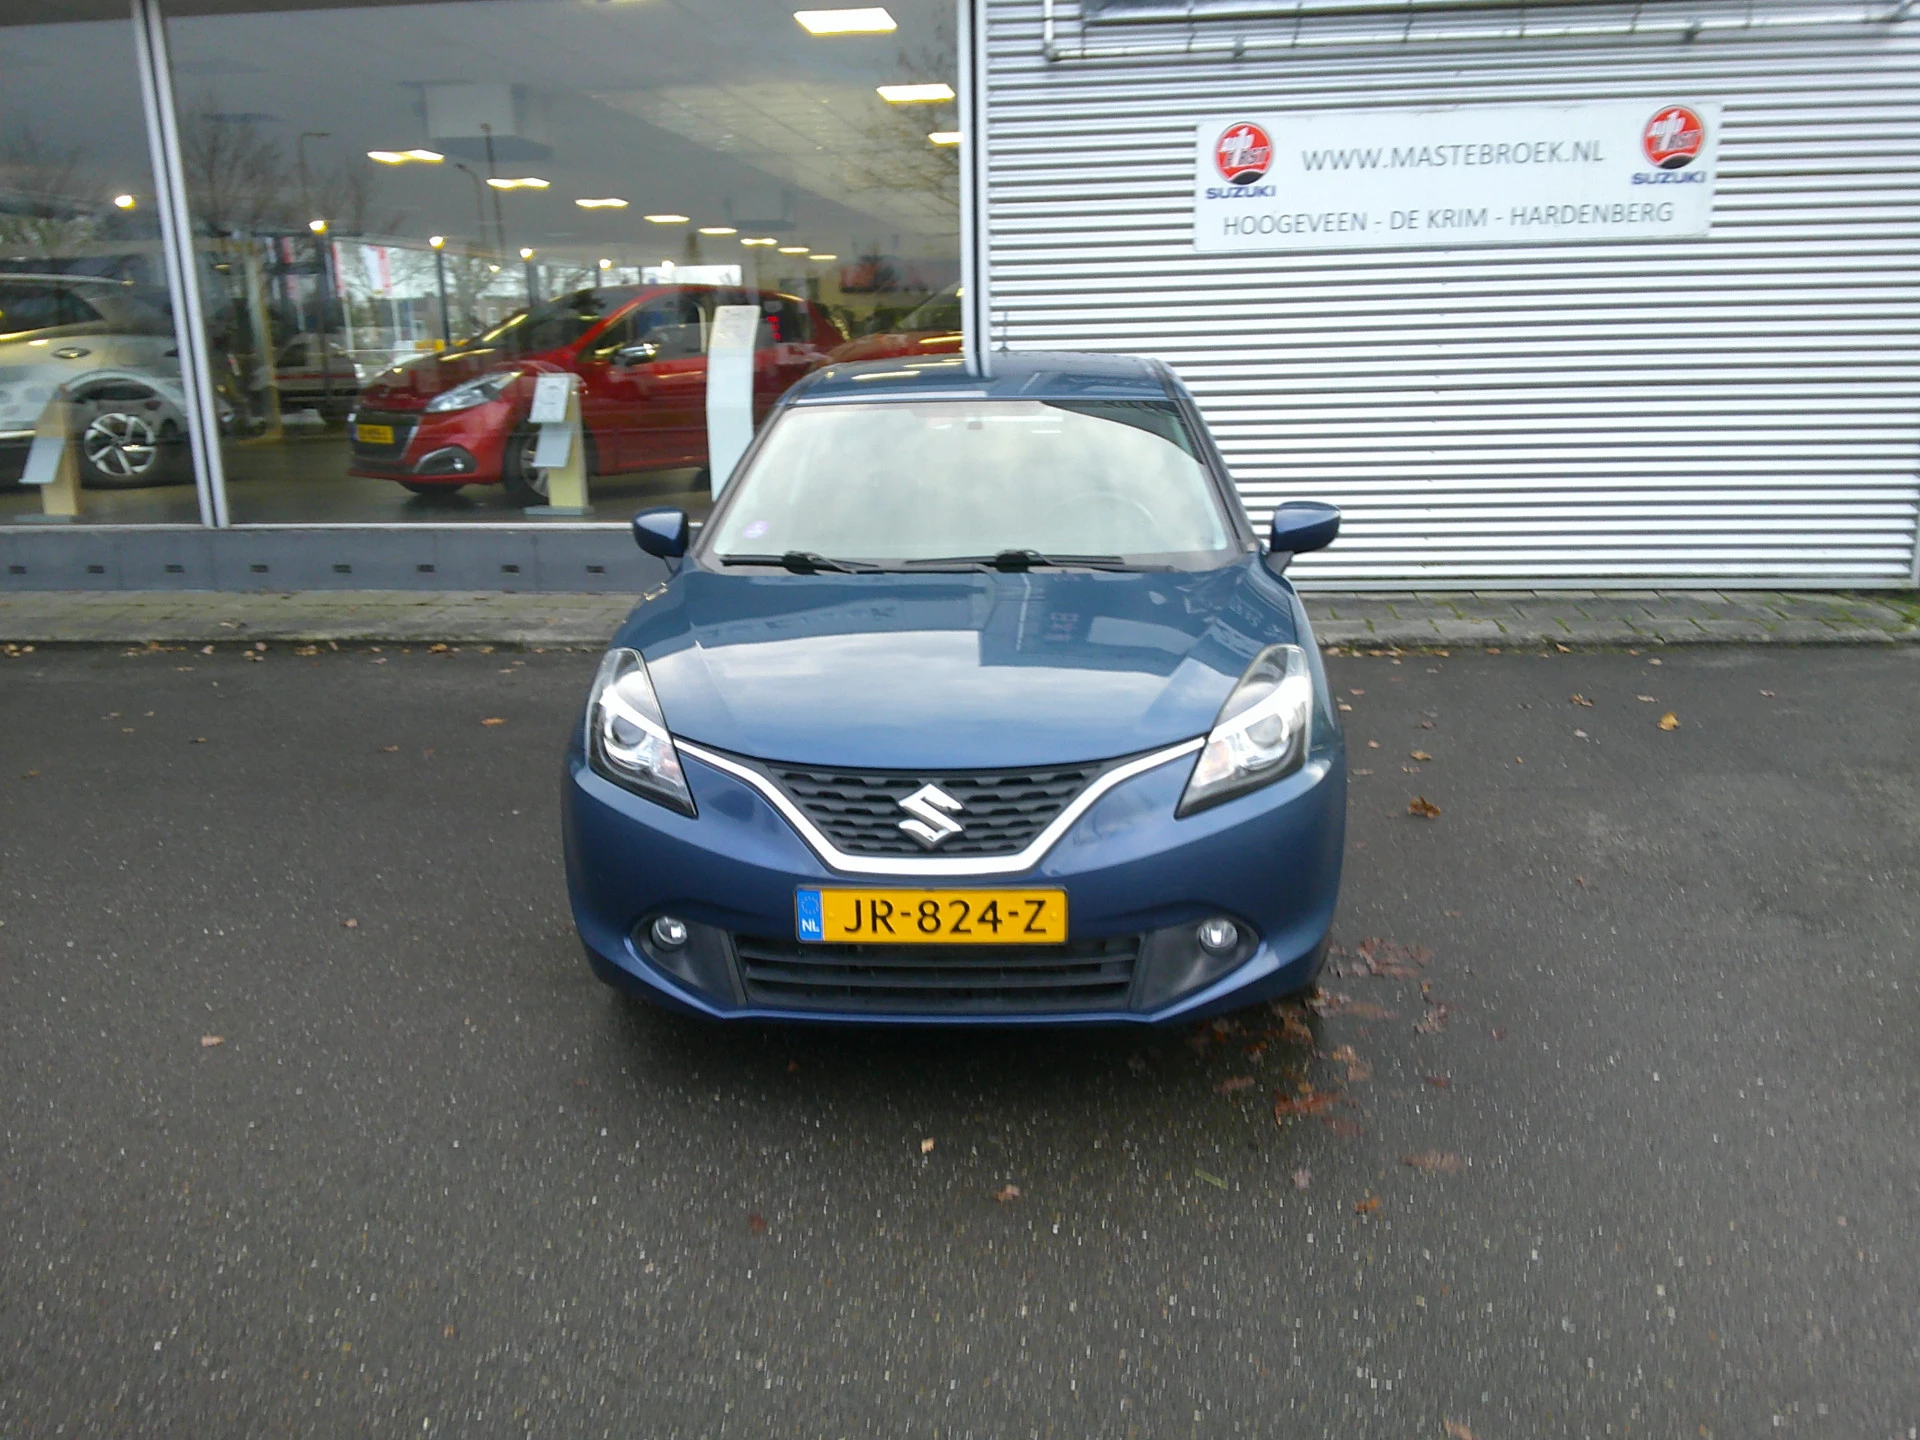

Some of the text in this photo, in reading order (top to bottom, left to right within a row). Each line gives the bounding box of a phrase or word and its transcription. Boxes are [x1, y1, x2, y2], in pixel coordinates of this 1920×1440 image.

[1301, 139, 1605, 172] WWW.MASTEBROEK.NL
[1631, 170, 1706, 185] SUZUKI
[1205, 185, 1276, 200] SUZUKI
[1223, 211, 1368, 236] HOOGEVEEN
[1390, 209, 1419, 230] DE
[1427, 207, 1488, 229] KRIM
[1510, 201, 1674, 226] HARDENBERG
[801, 918, 820, 932] NL
[843, 899, 1048, 934] JR-824-Z
